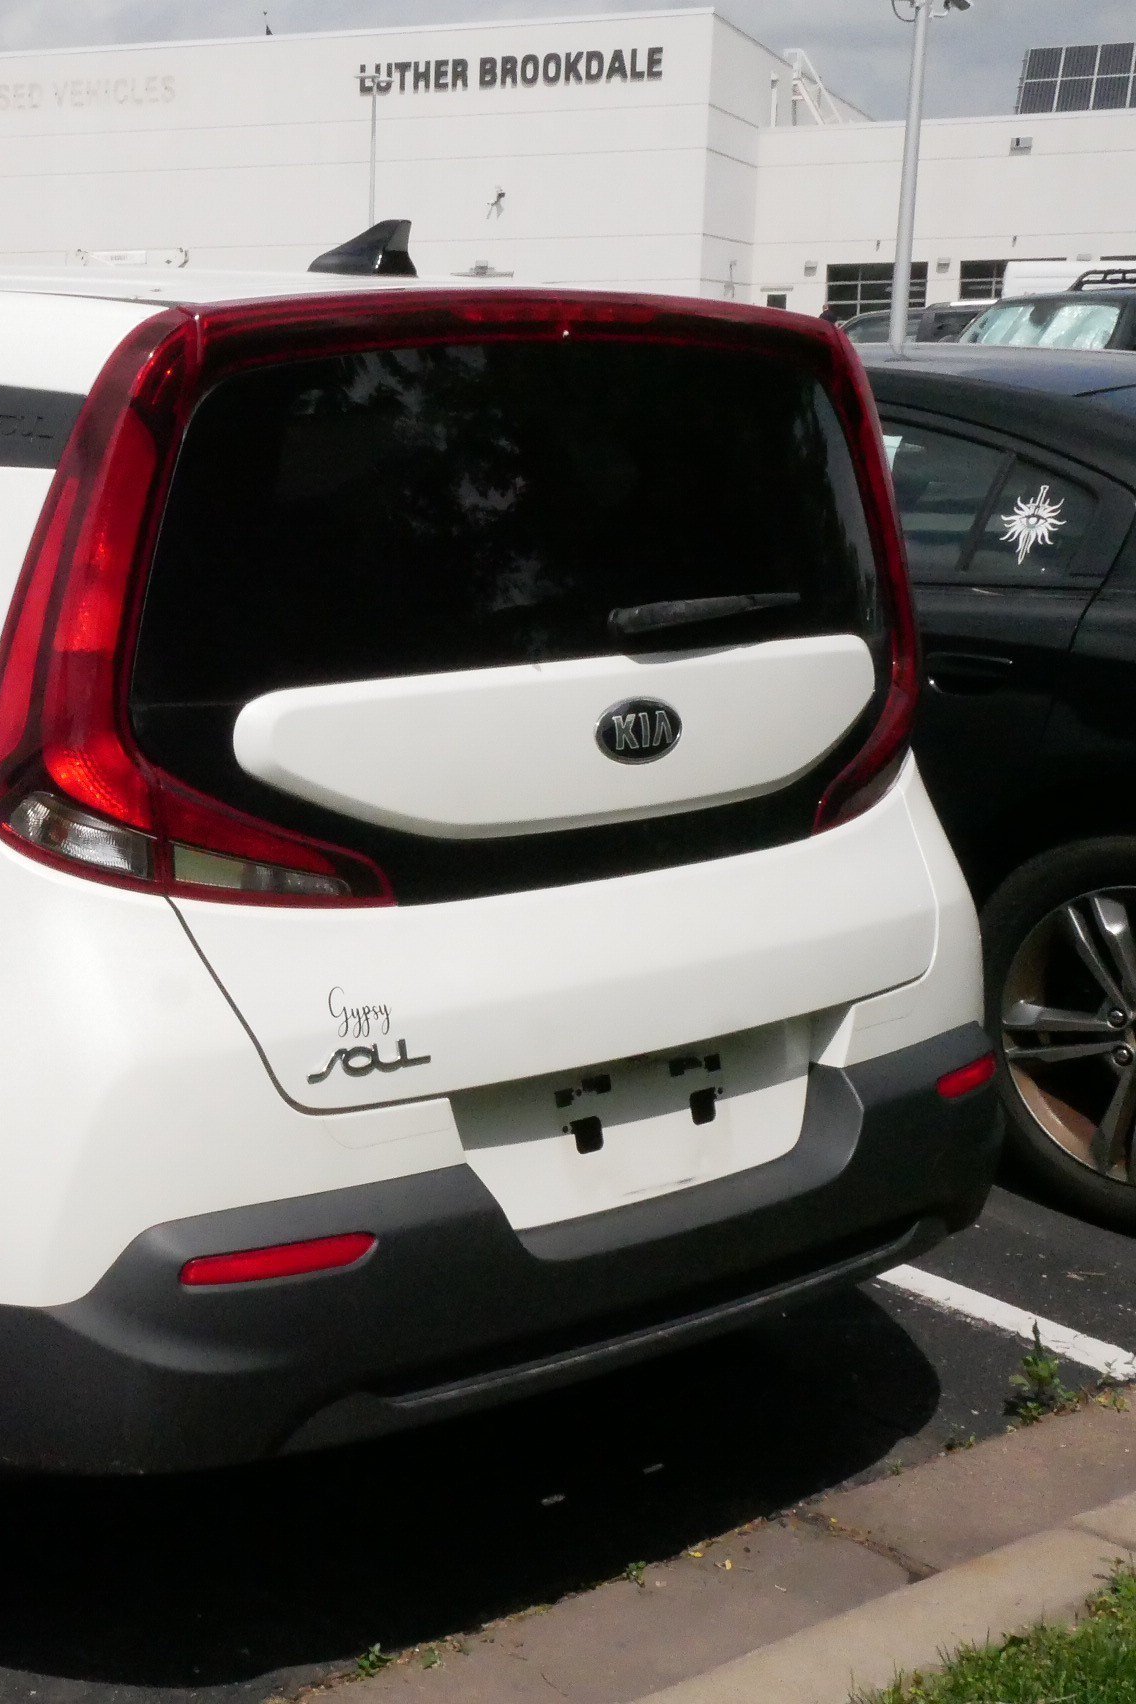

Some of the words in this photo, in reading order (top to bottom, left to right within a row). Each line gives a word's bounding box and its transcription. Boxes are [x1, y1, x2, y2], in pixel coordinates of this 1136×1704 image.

[359, 57, 468, 95] LUTHER
[478, 47, 664, 89] BROOKDALE
[612, 710, 673, 750] KIA
[328, 986, 393, 1038] Gypsy
